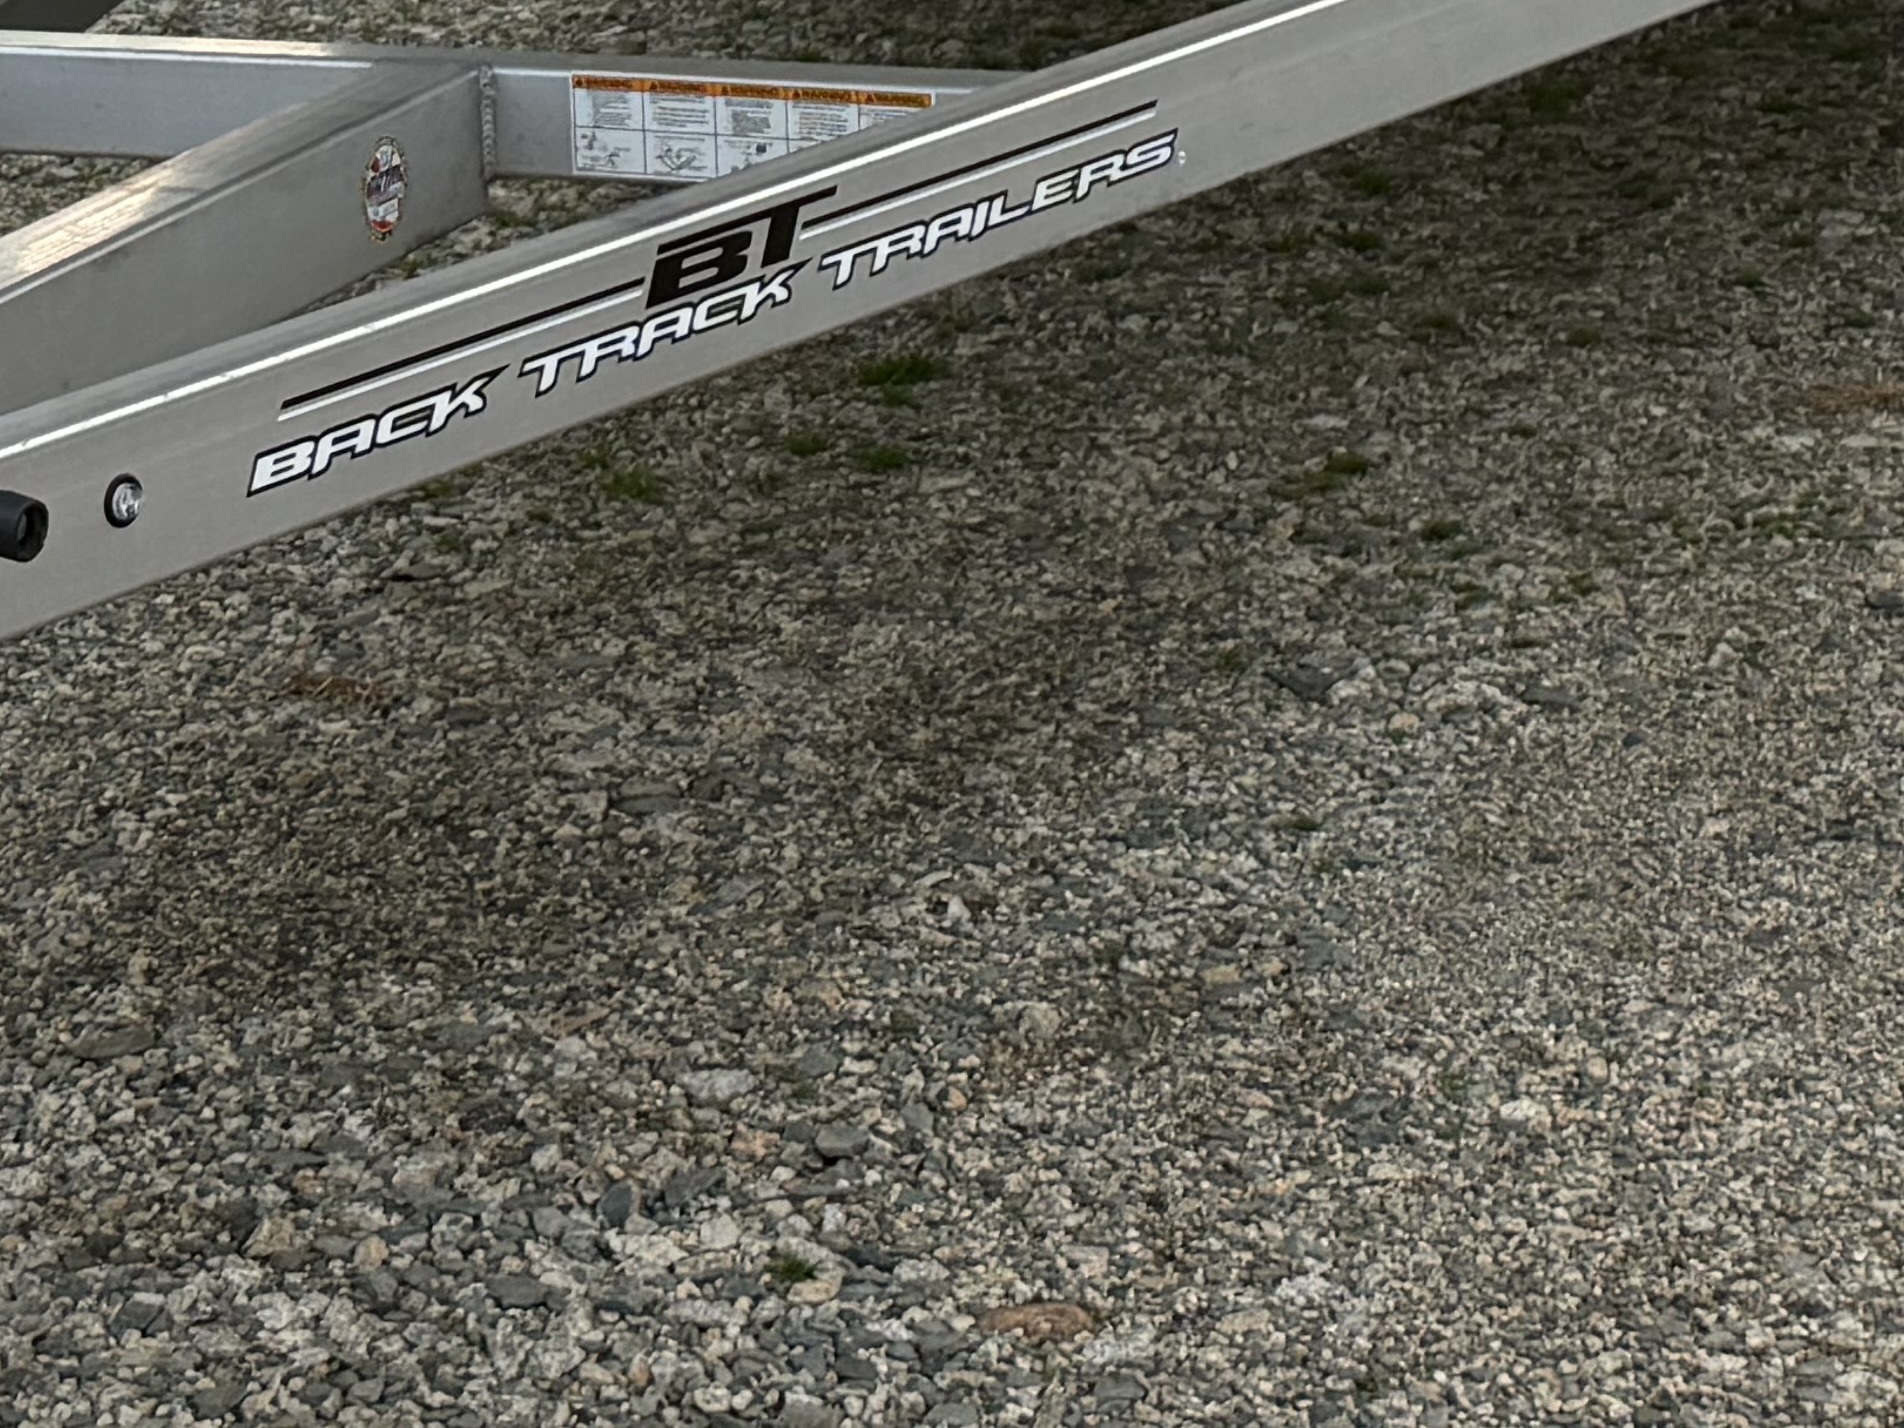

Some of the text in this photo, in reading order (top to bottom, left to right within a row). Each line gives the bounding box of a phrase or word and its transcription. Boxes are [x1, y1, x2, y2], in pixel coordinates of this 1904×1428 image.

[247, 128, 1179, 498] BACK TRACK TRAILERS
[645, 185, 838, 310] BT
